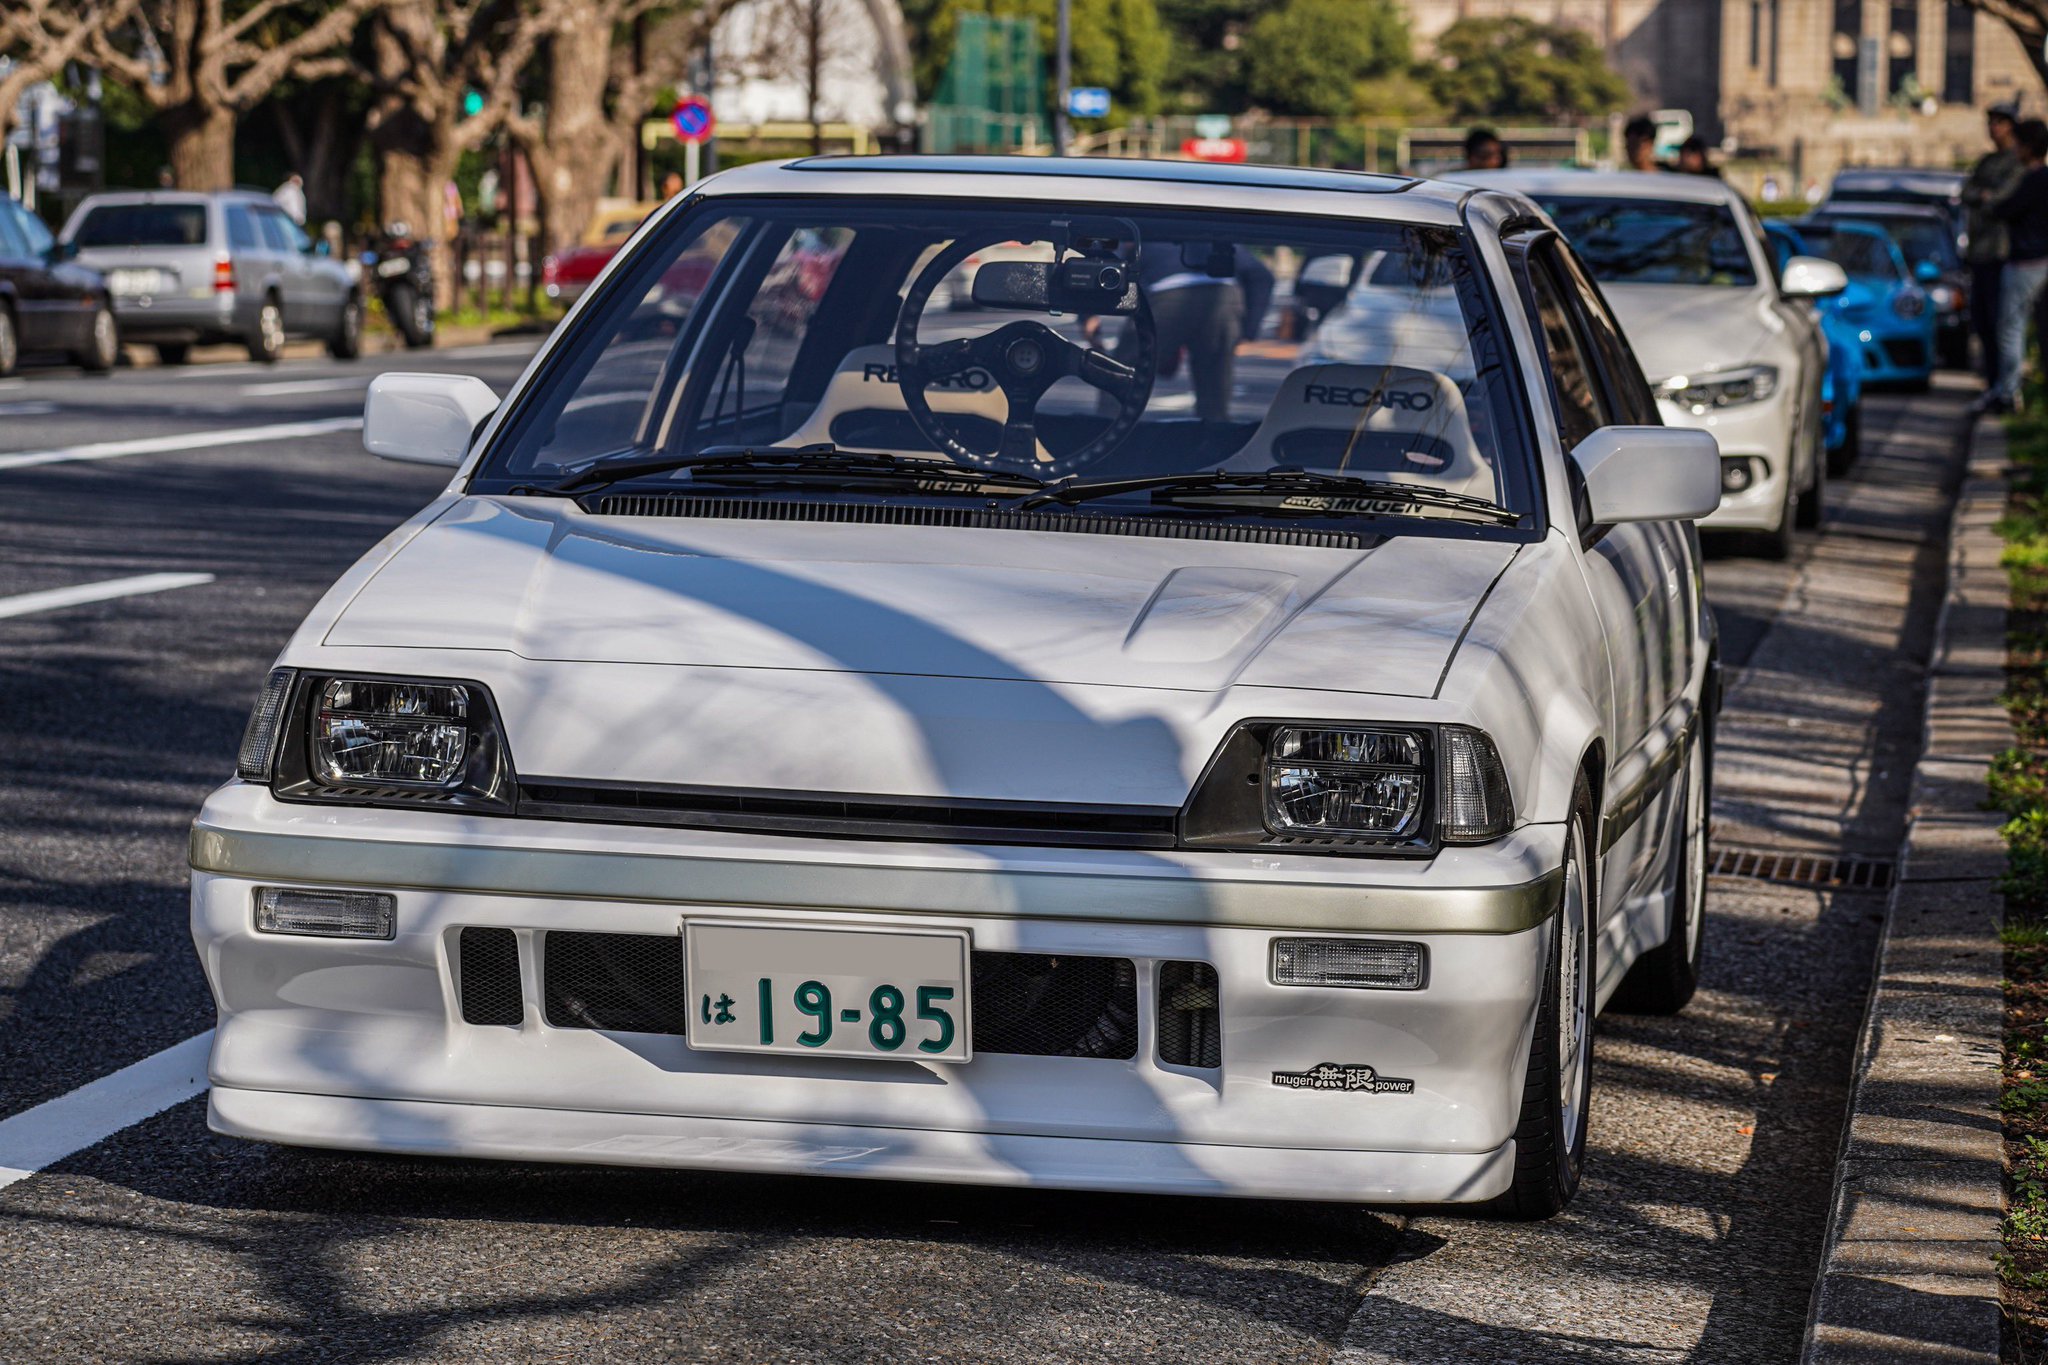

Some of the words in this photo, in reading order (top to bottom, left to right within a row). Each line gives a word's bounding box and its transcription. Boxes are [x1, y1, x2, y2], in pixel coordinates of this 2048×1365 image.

[1303, 384, 1433, 411] RECARO
[701, 992, 737, 1025] は
[758, 977, 955, 1054] 19-85
[1274, 1073, 1314, 1087] mugen
[1310, 1066, 1375, 1090] 無限
[1375, 1080, 1412, 1092] power
